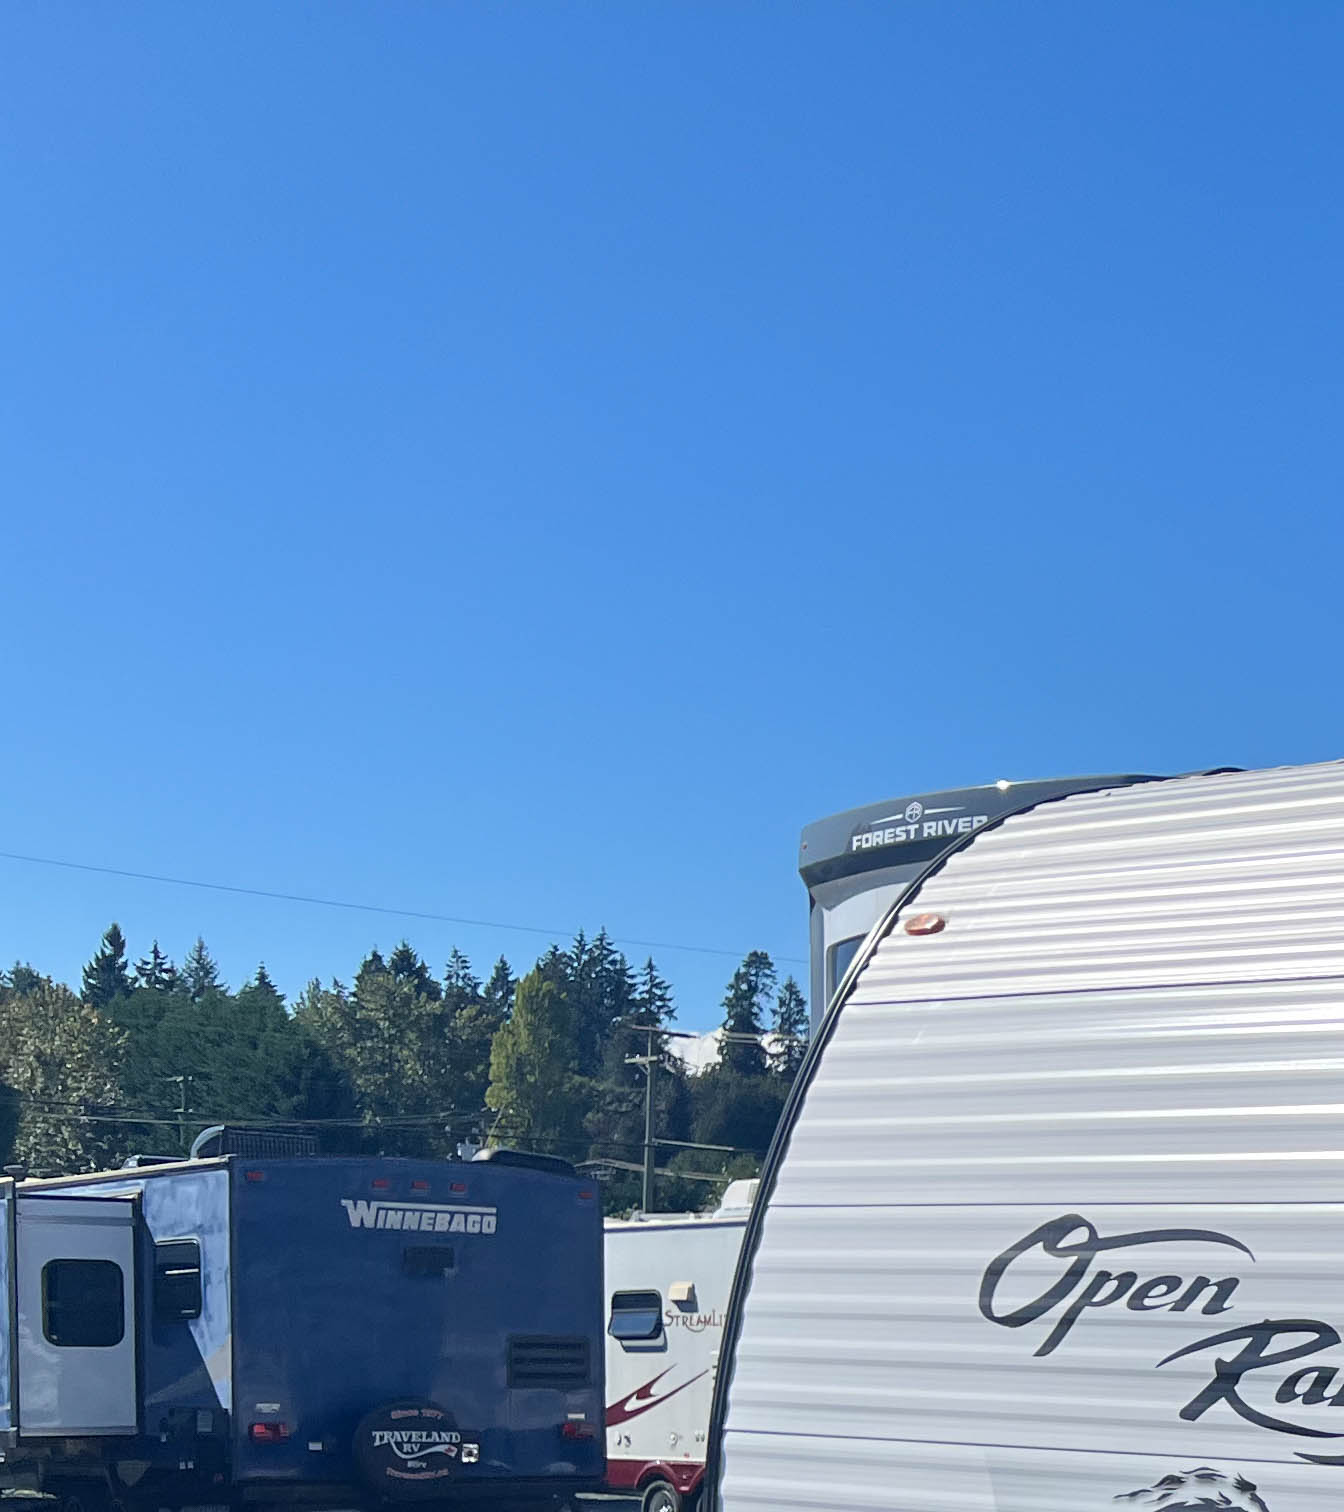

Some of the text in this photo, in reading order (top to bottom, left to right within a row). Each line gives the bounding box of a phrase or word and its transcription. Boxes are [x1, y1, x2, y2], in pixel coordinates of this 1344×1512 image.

[852, 823, 920, 851] FOREST
[340, 1199, 497, 1235] WINNEBAGO
[977, 1213, 1256, 1356] Open
[372, 1431, 461, 1447] TRAVELAND
[403, 1443, 420, 1453] RV
